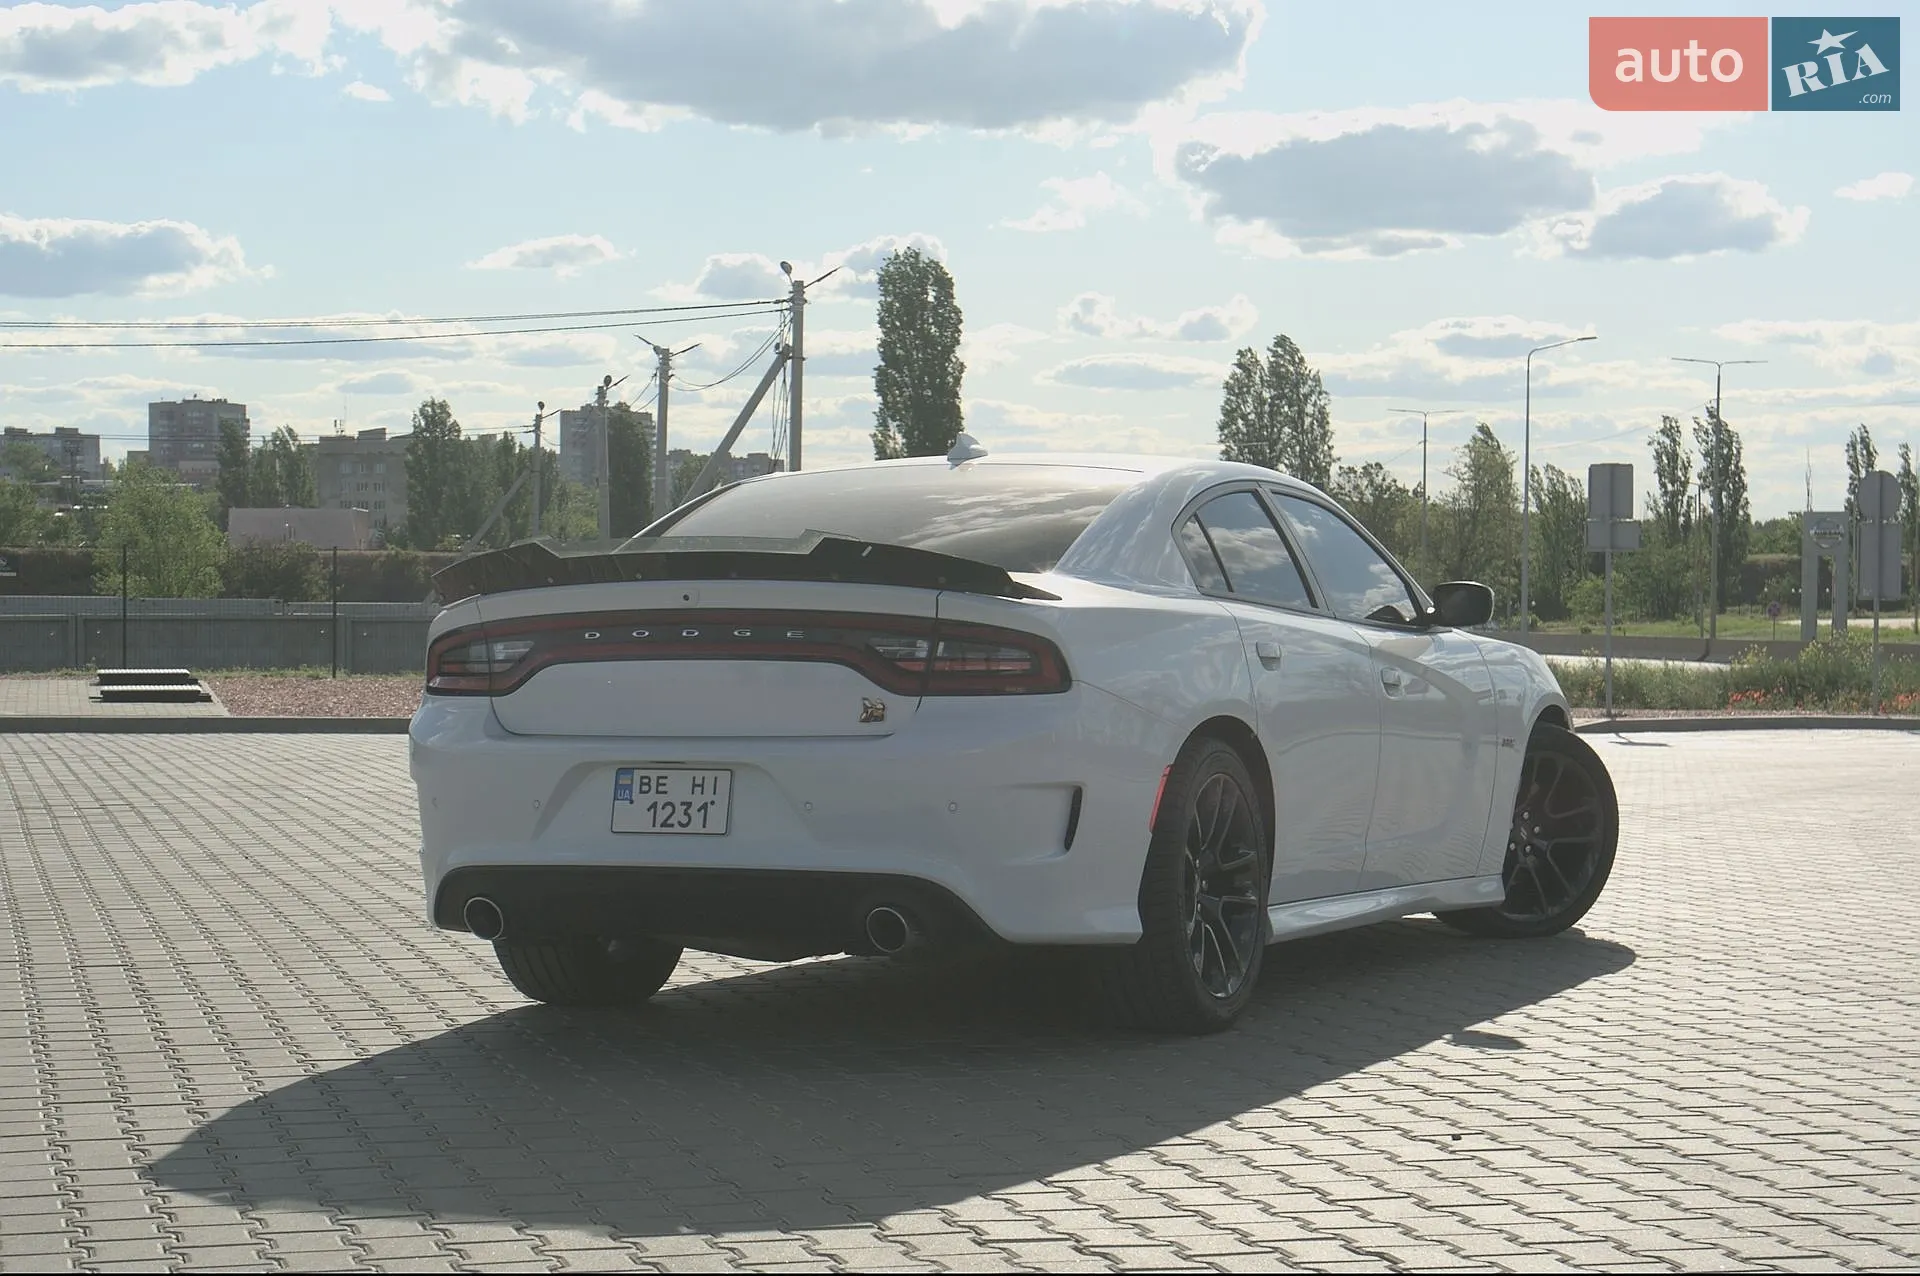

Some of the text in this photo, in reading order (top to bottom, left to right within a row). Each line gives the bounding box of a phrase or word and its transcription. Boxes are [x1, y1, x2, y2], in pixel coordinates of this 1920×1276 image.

[585, 629, 804, 639] DODGE
[638, 775, 718, 795] BE HI
[617, 789, 631, 800] UA
[646, 801, 709, 829] 1231
